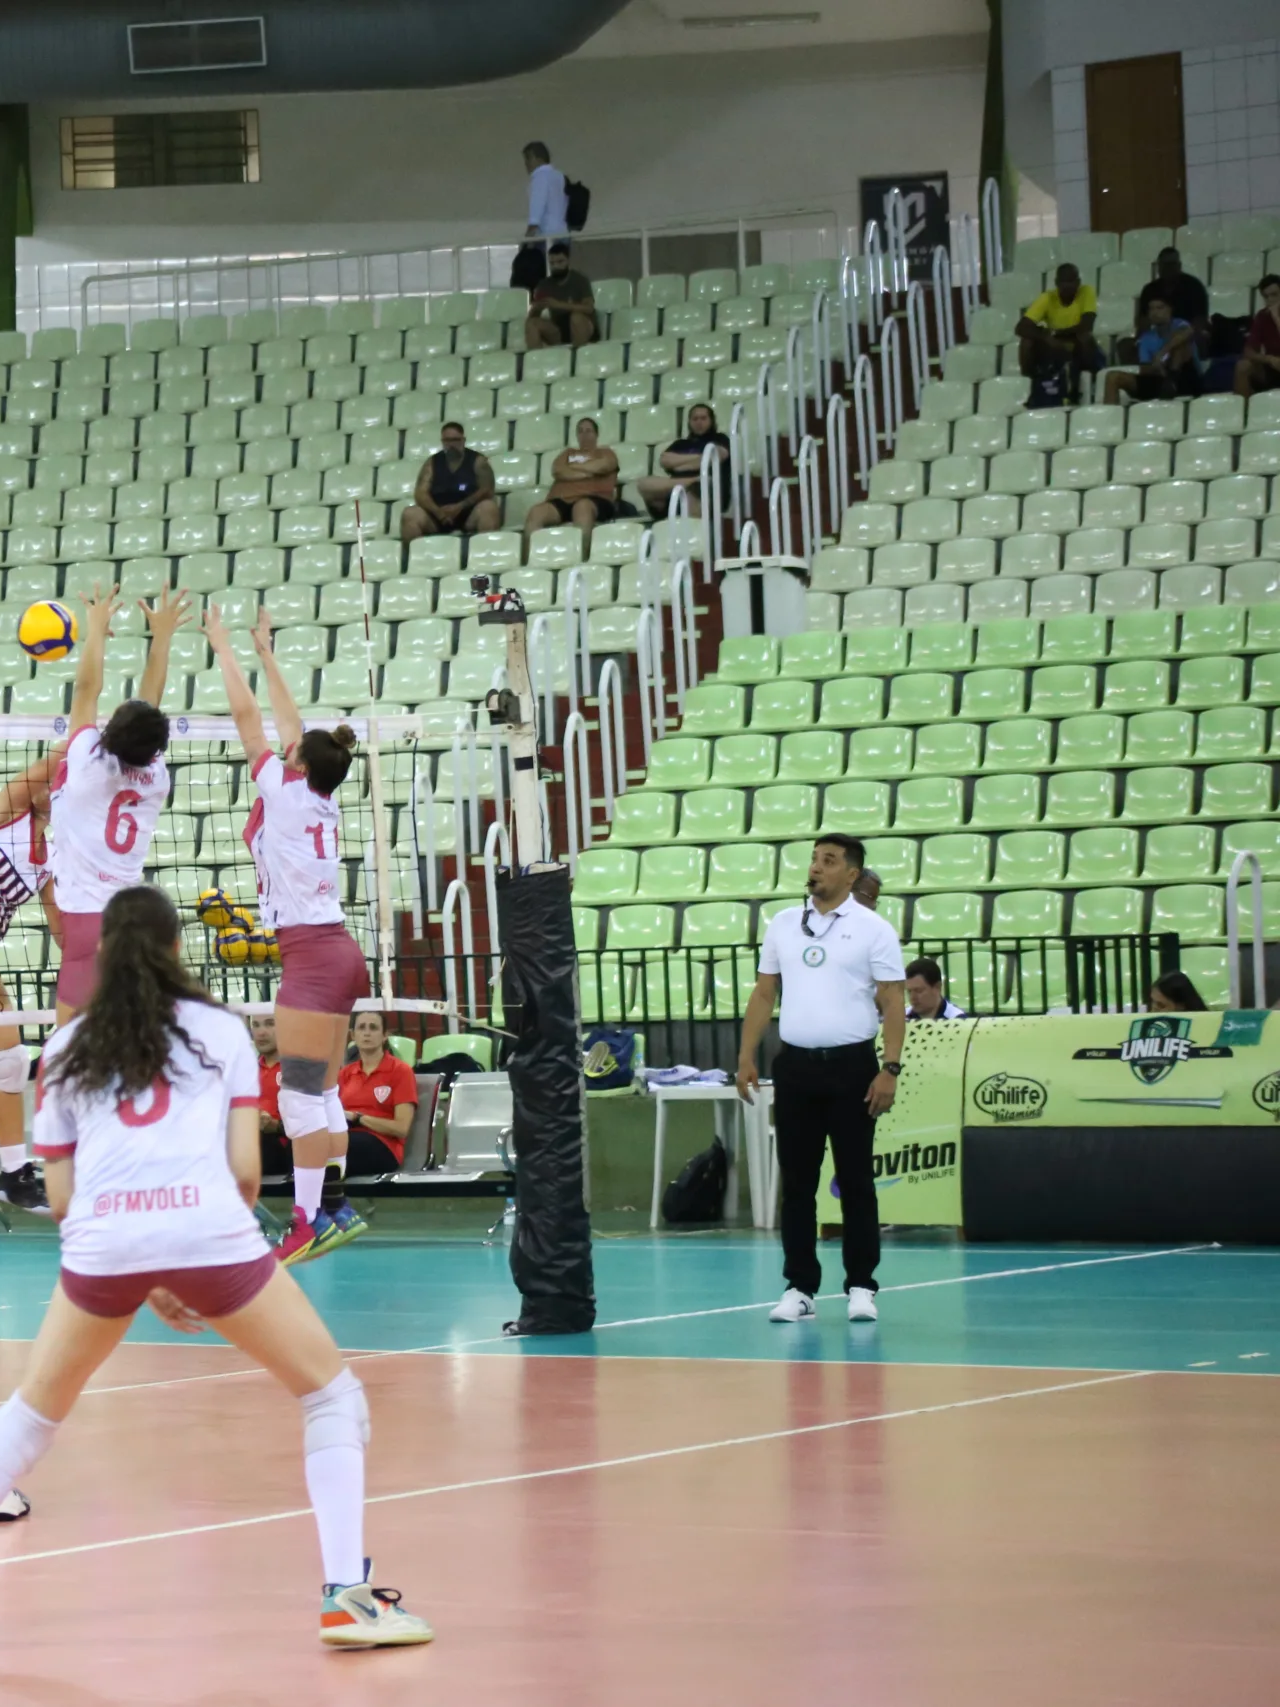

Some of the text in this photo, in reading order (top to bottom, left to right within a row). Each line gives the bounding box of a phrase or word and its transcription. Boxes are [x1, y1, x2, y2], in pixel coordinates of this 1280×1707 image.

[104, 789, 142, 855] 6
[1120, 1037, 1192, 1061] UNILIFE
[981, 1085, 1041, 1105] unilife
[908, 1168, 955, 1184] By UNILIFE
[93, 1185, 200, 1218] @FMVOLEI
